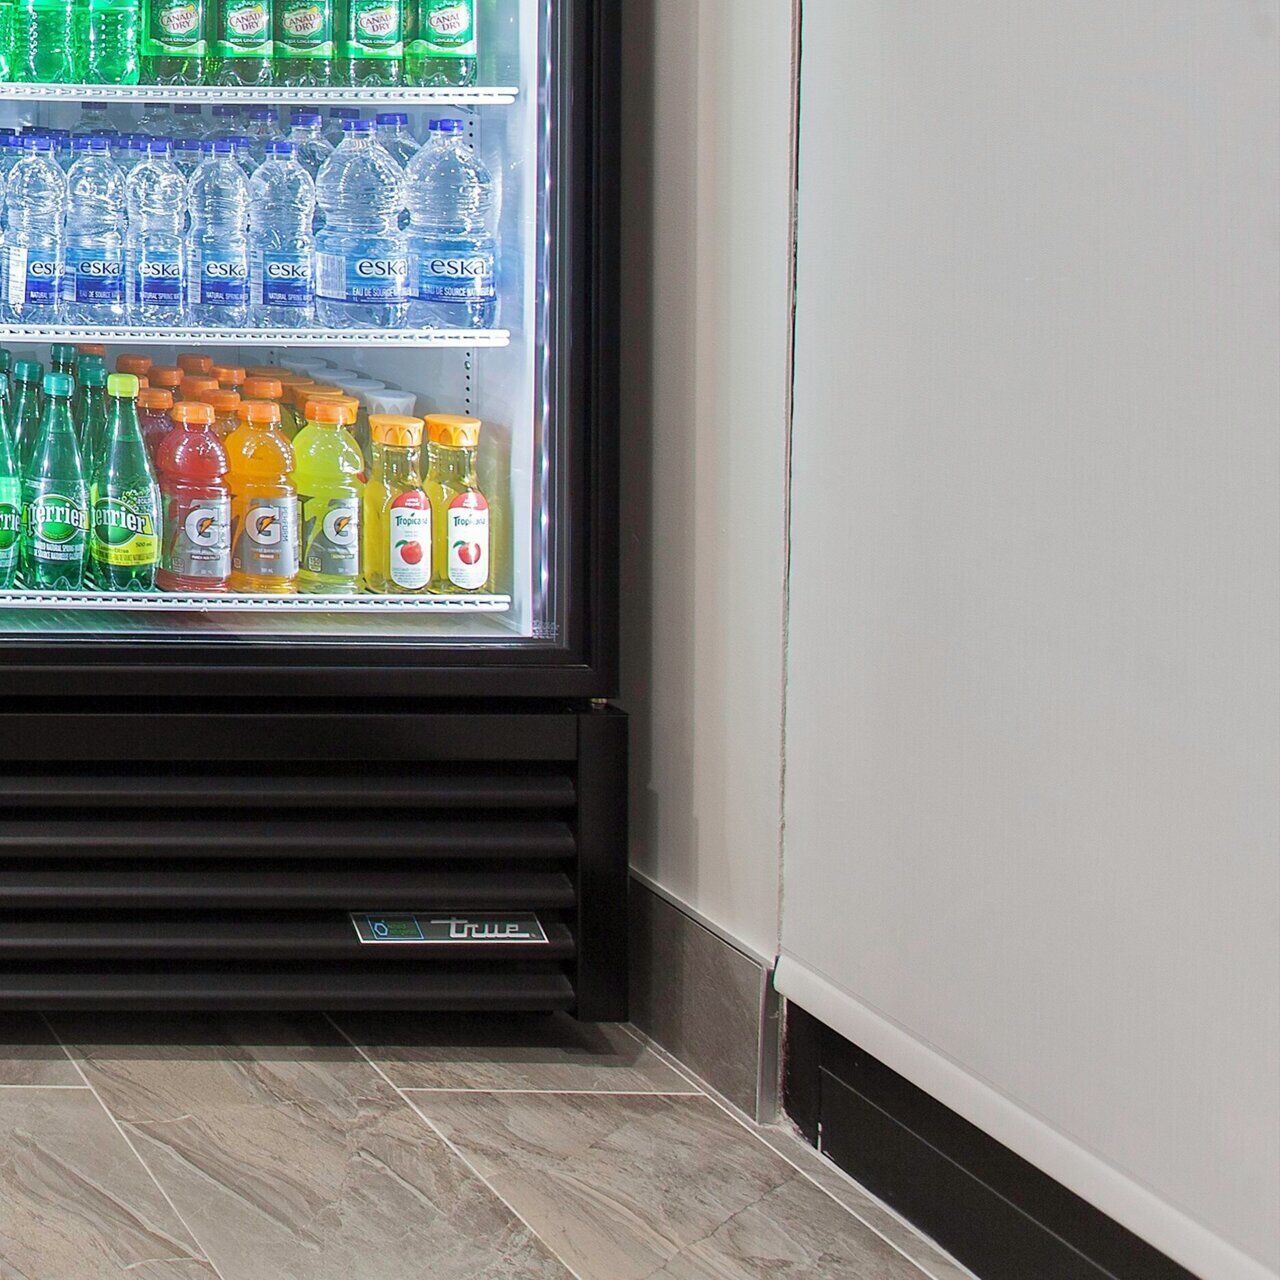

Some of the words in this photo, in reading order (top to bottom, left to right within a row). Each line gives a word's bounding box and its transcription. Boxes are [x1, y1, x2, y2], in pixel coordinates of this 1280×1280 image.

[172, 21, 191, 31] DRY
[241, 21, 261, 32] DRY
[295, 22, 316, 33] DRY
[372, 21, 391, 33] DRY
[442, 20, 460, 32] DRY
[80, 260, 120, 274] eska
[358, 259, 408, 276] eska
[430, 259, 485, 276] eska
[185, 507, 220, 547] G
[245, 505, 281, 546] G
[322, 506, 358, 547] G
[430, 917, 530, 938] true
